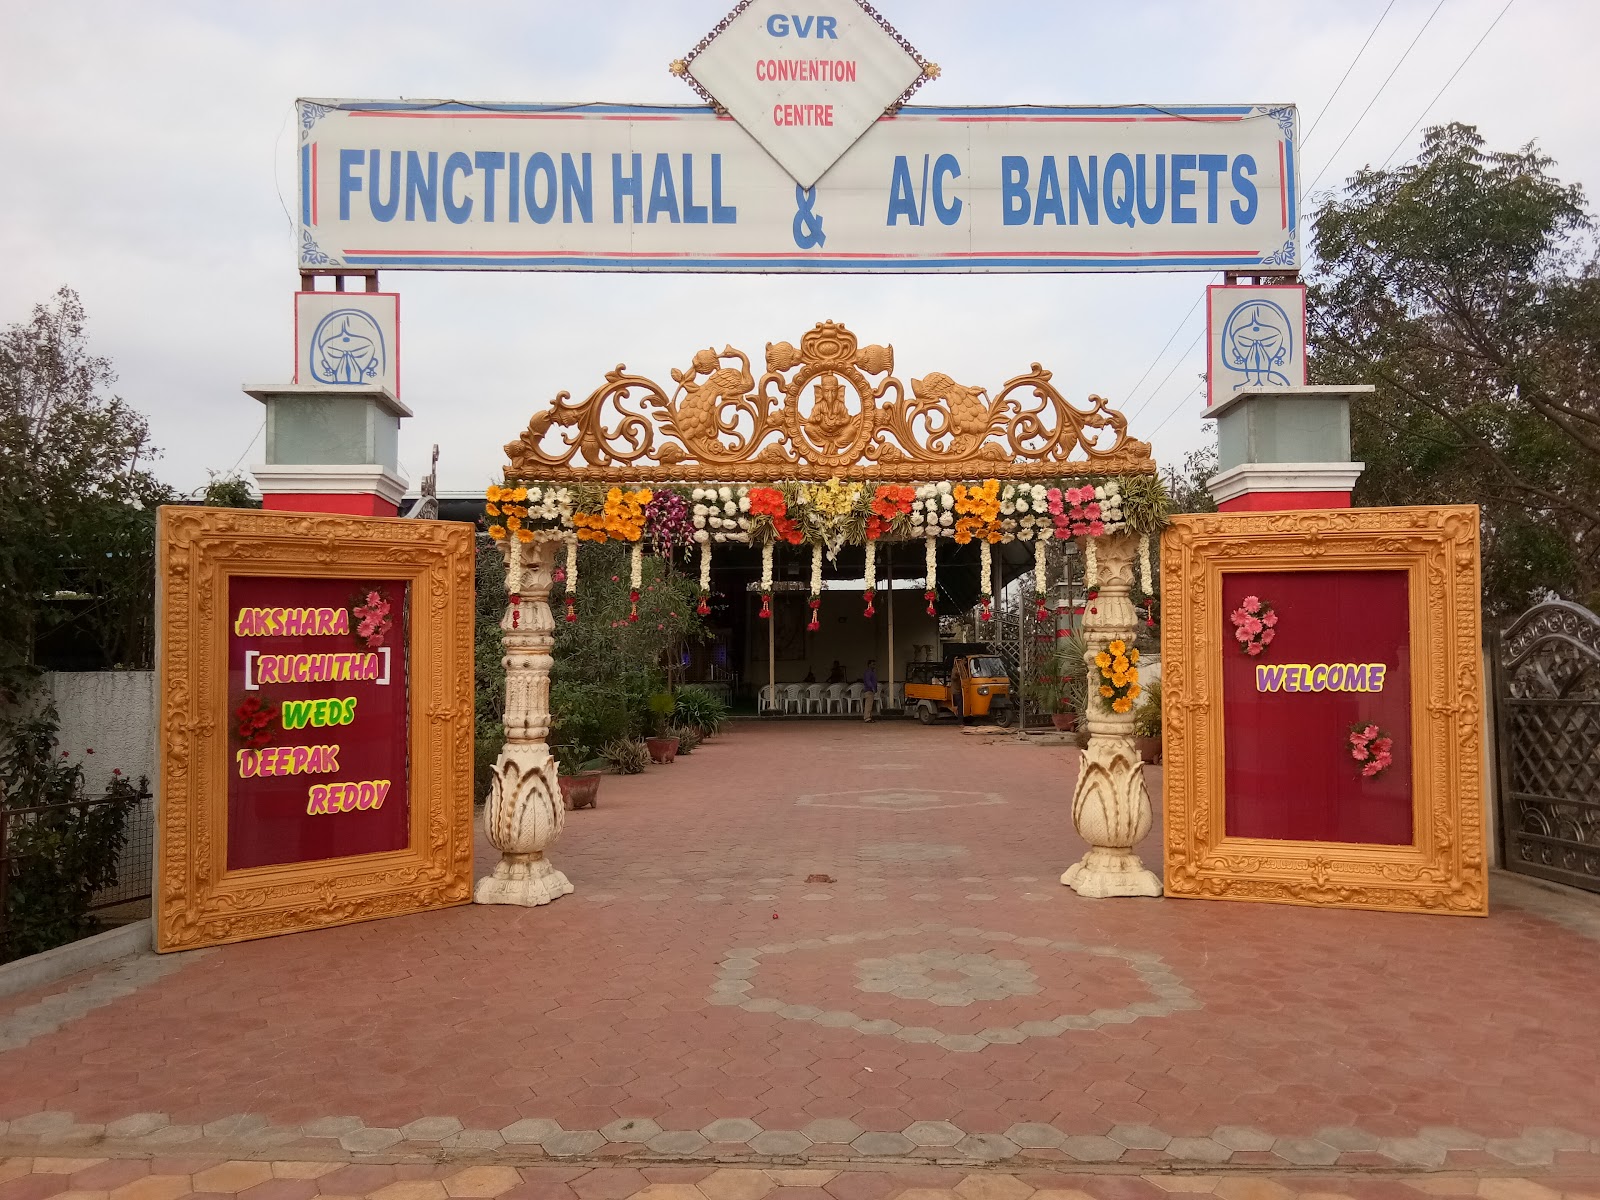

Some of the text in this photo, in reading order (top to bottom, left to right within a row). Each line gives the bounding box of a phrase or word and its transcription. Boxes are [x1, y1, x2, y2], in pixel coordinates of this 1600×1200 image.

[766, 14, 838, 40] GVR
[756, 59, 857, 82] CONVENTION
[773, 104, 834, 127] CENTRE
[339, 148, 1259, 250] FUNCTION HALL & A/C BANQUETS
[235, 607, 350, 638] AKSHARA
[1255, 662, 1387, 693] WELCOME
[282, 696, 358, 731] WEDS
[236, 744, 341, 779] DEEPAK
[307, 780, 390, 814] REDDY
